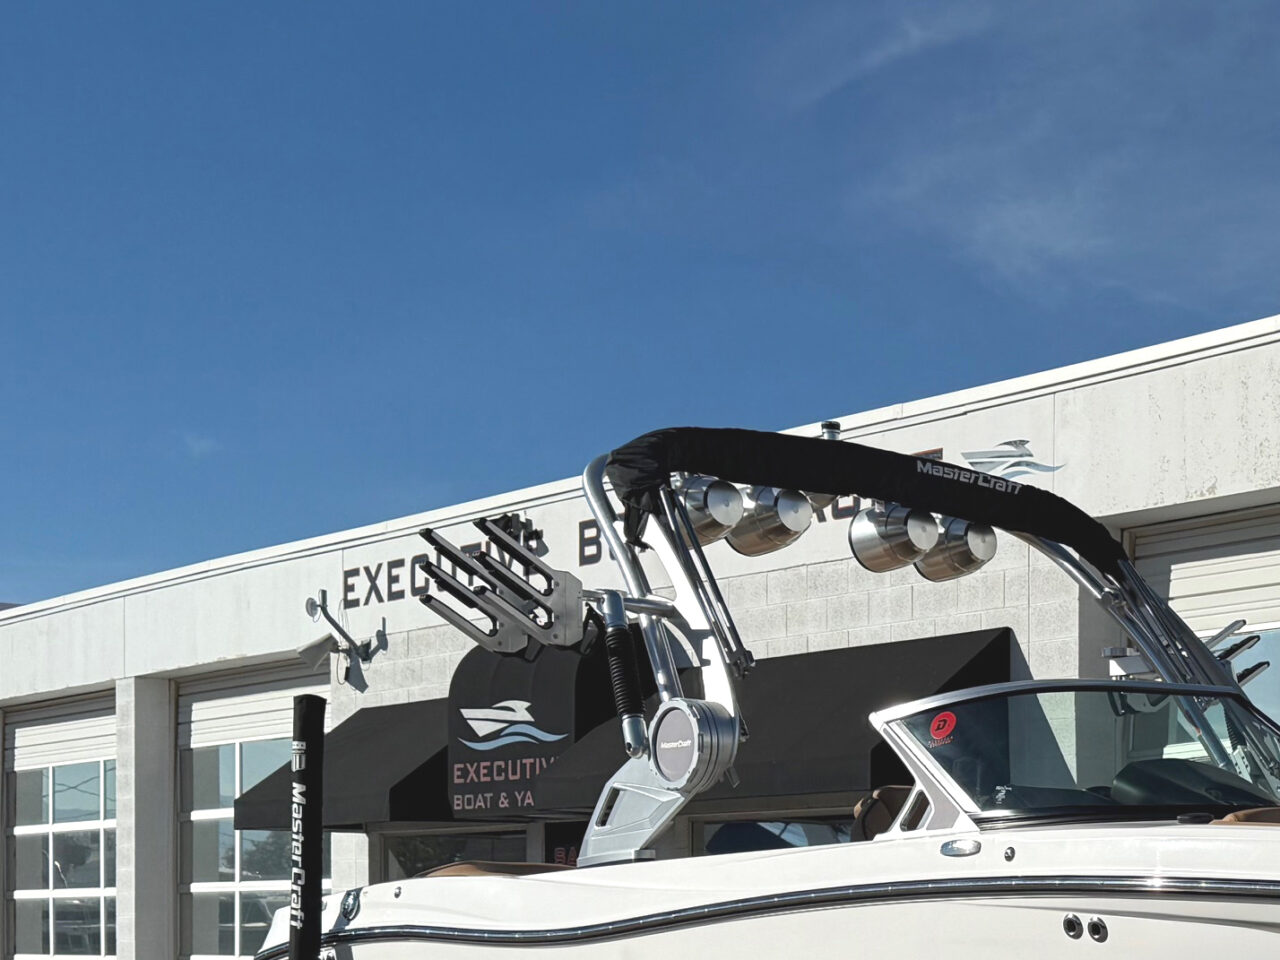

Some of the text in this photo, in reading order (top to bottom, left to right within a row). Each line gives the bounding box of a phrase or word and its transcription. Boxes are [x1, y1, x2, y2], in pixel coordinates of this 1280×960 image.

[916, 460, 1022, 495] MasterCraft
[660, 739, 692, 749] MasterCraft
[453, 756, 559, 784] EXECUTI
[453, 793, 493, 810] BOAT
[498, 792, 509, 808] &
[290, 782, 307, 929] MasterCraft
